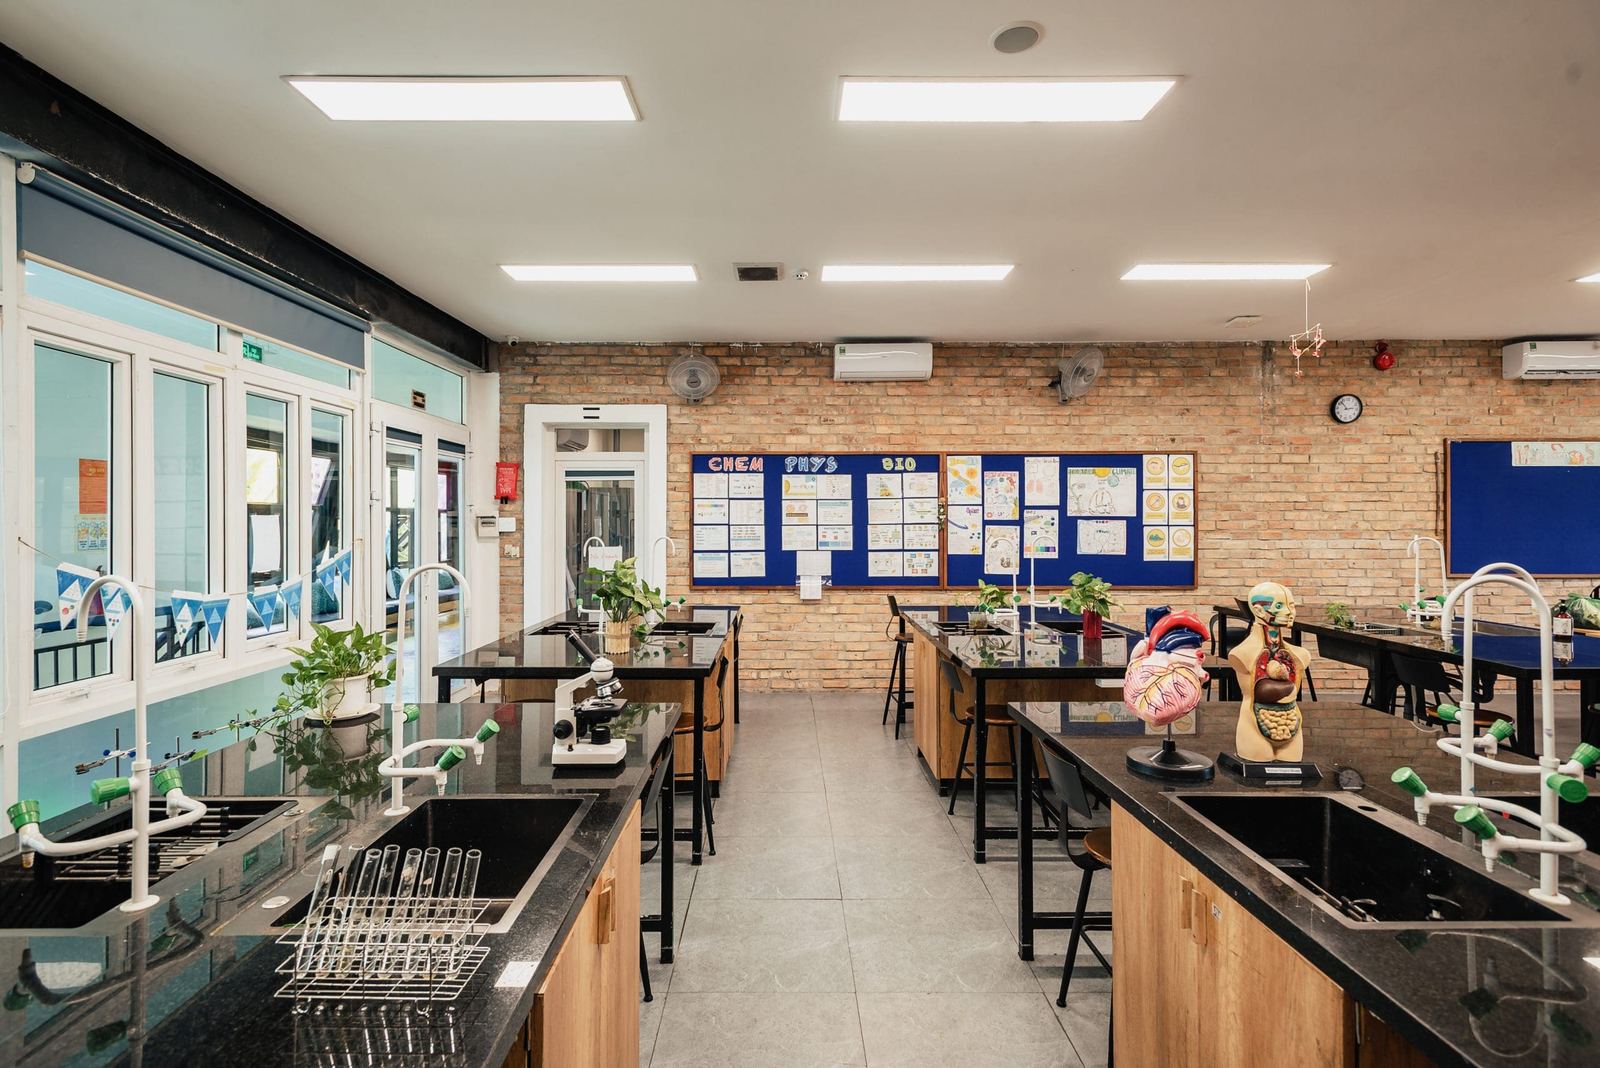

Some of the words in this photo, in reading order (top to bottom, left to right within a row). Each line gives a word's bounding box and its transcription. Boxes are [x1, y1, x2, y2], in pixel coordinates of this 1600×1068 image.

[708, 456, 764, 472] CHEM
[784, 456, 838, 473] PHYS
[882, 457, 917, 471] BIO
